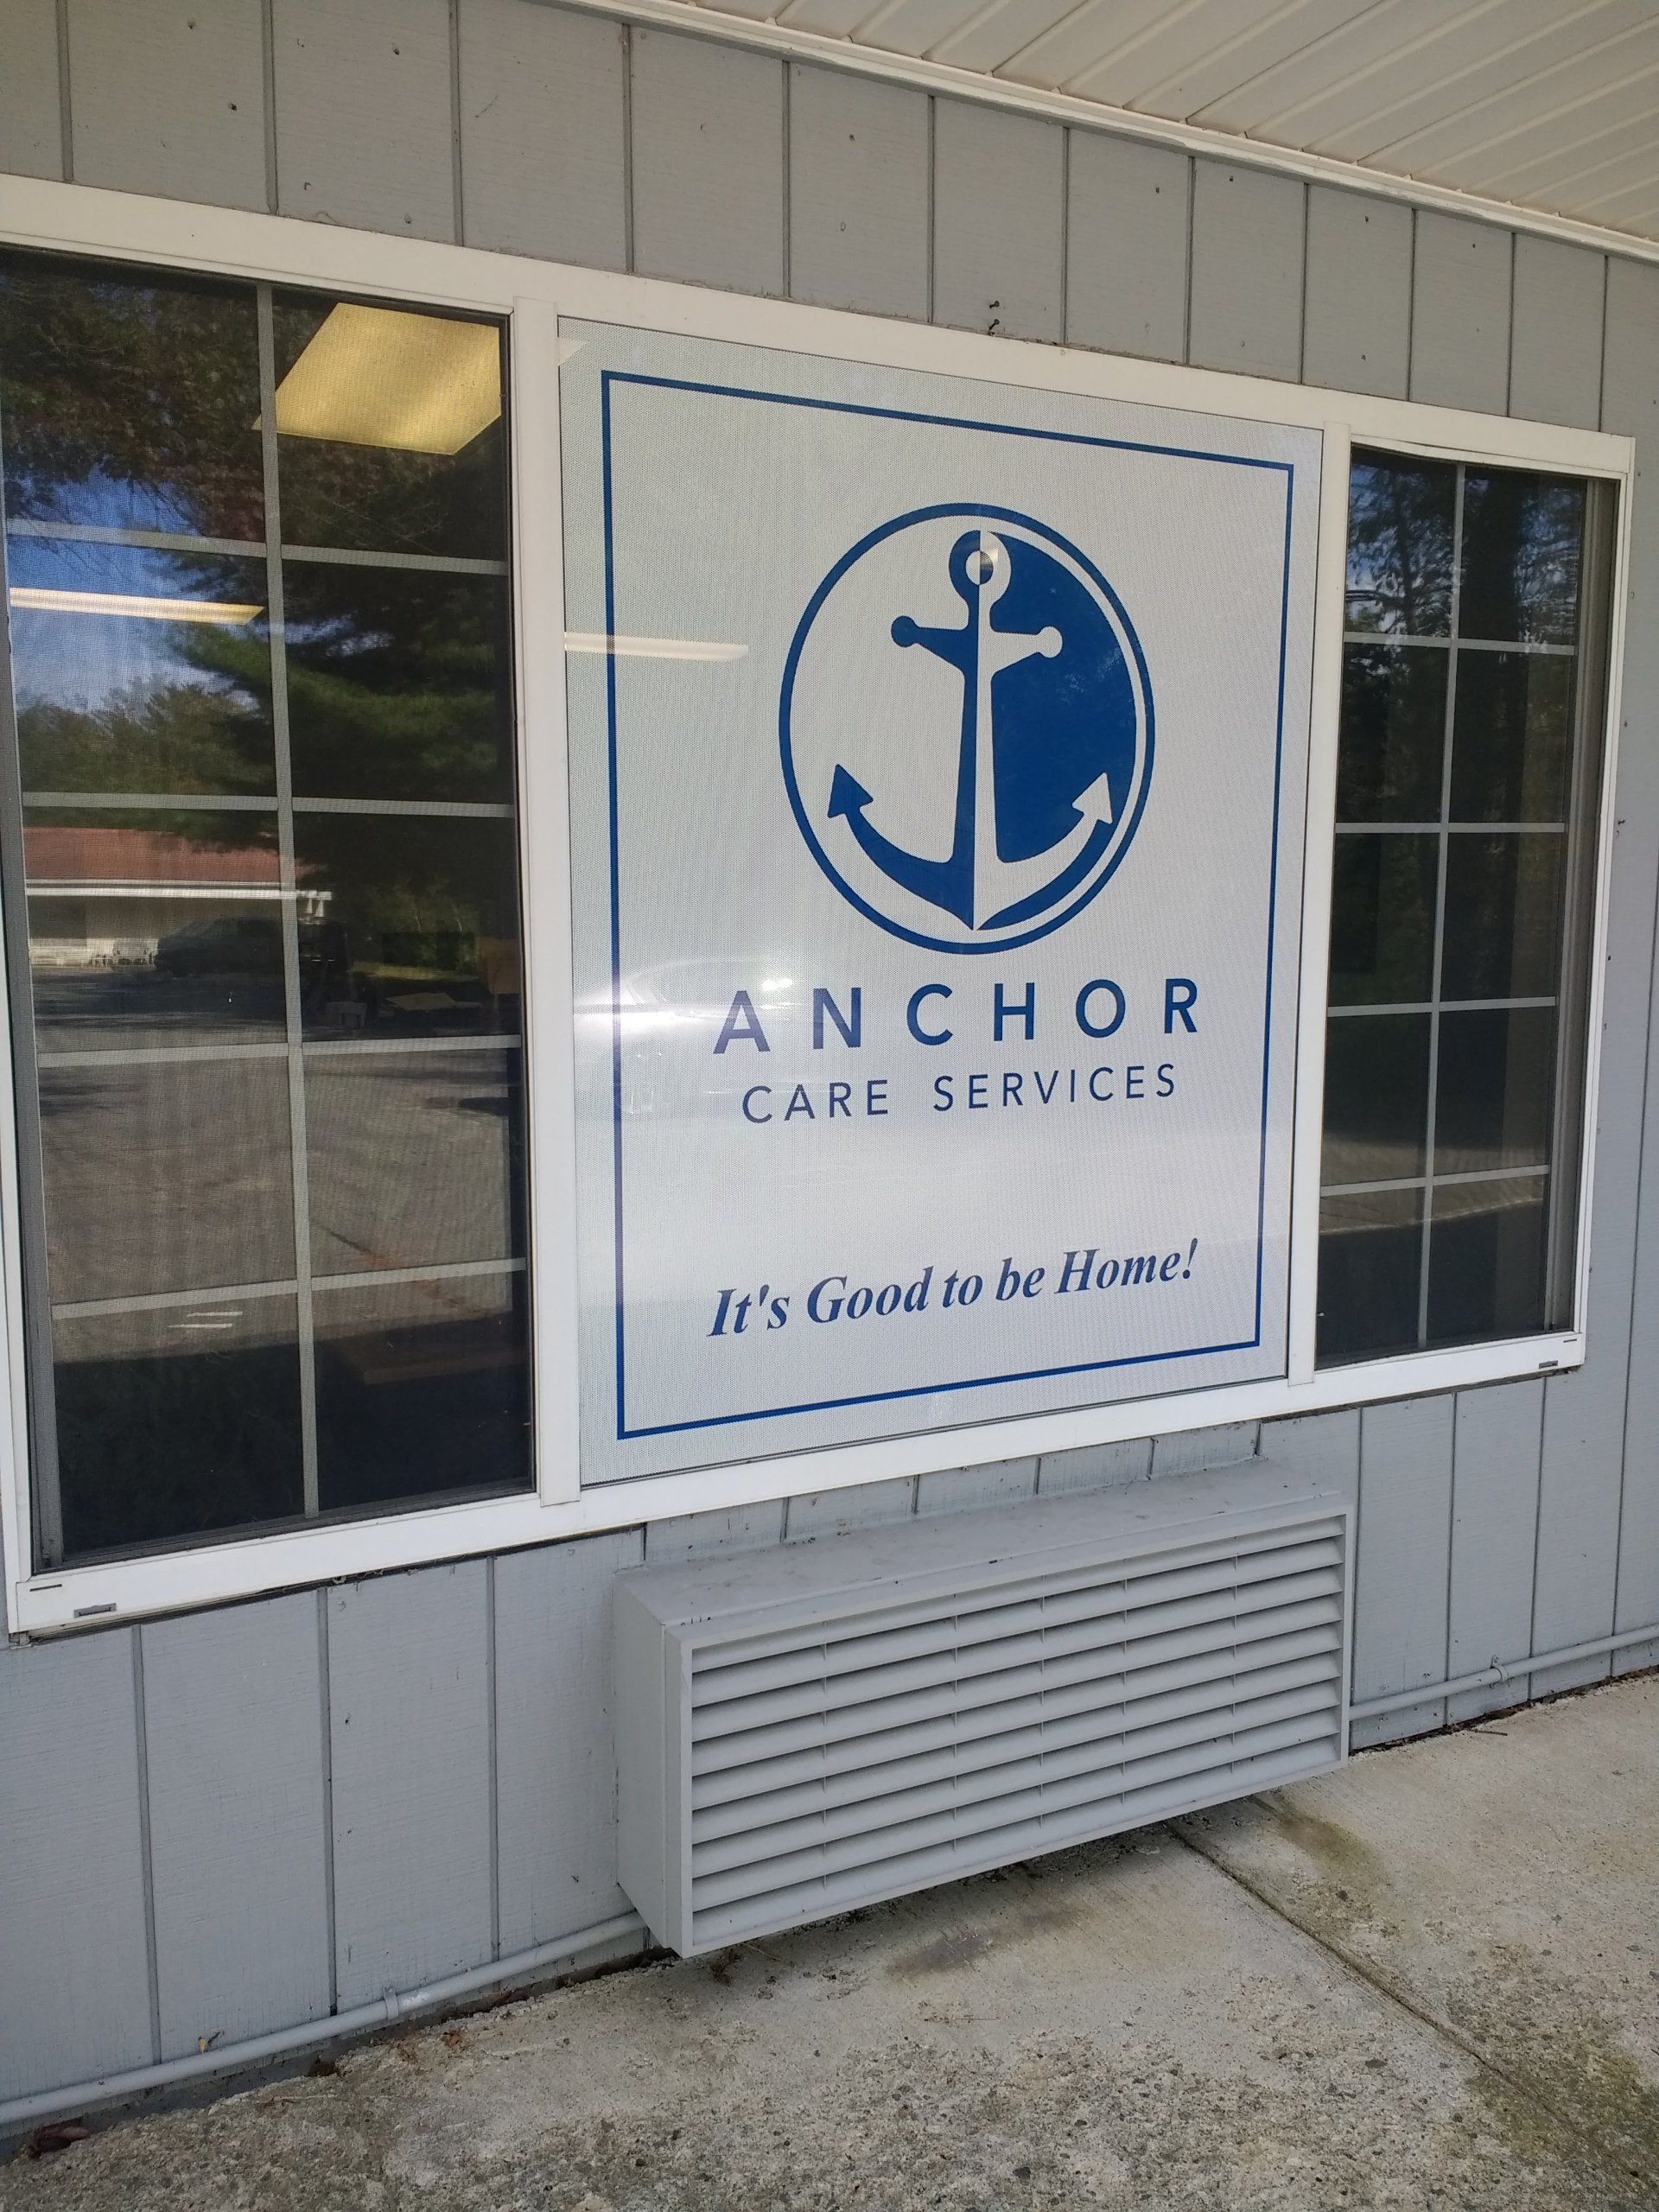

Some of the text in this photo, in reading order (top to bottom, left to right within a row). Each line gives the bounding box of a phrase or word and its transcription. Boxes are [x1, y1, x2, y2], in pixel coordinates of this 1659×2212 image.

[713, 977, 1198, 1054] ANCHOR
[741, 1063, 1176, 1123] CARE SERVICES
[706, 1237, 1198, 1338] It's Good to be Home!
